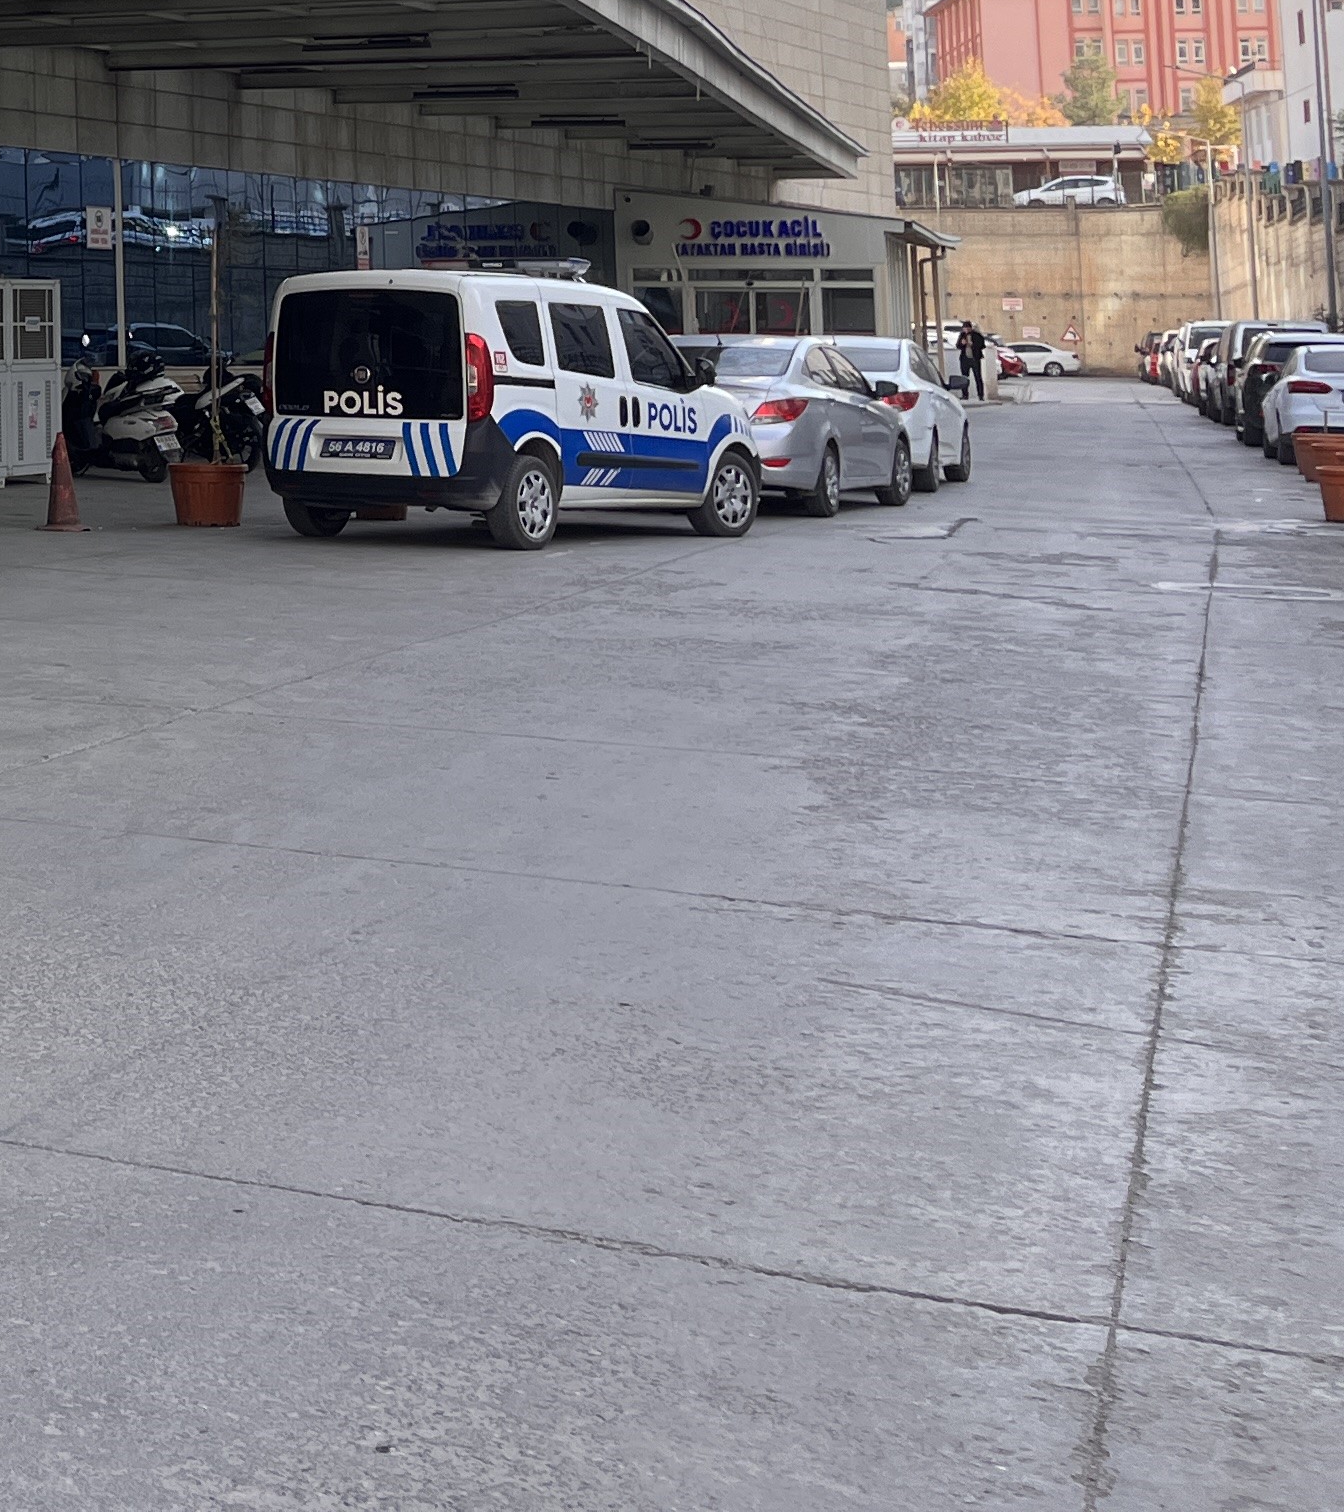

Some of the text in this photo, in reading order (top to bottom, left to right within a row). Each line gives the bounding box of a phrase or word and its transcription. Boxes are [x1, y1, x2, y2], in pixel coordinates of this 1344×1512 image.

[710, 215, 823, 240] ÇOCUK ACİL
[323, 384, 404, 416] POLİS
[647, 397, 698, 435] POLİS
[328, 441, 385, 453] 56 A 4816
